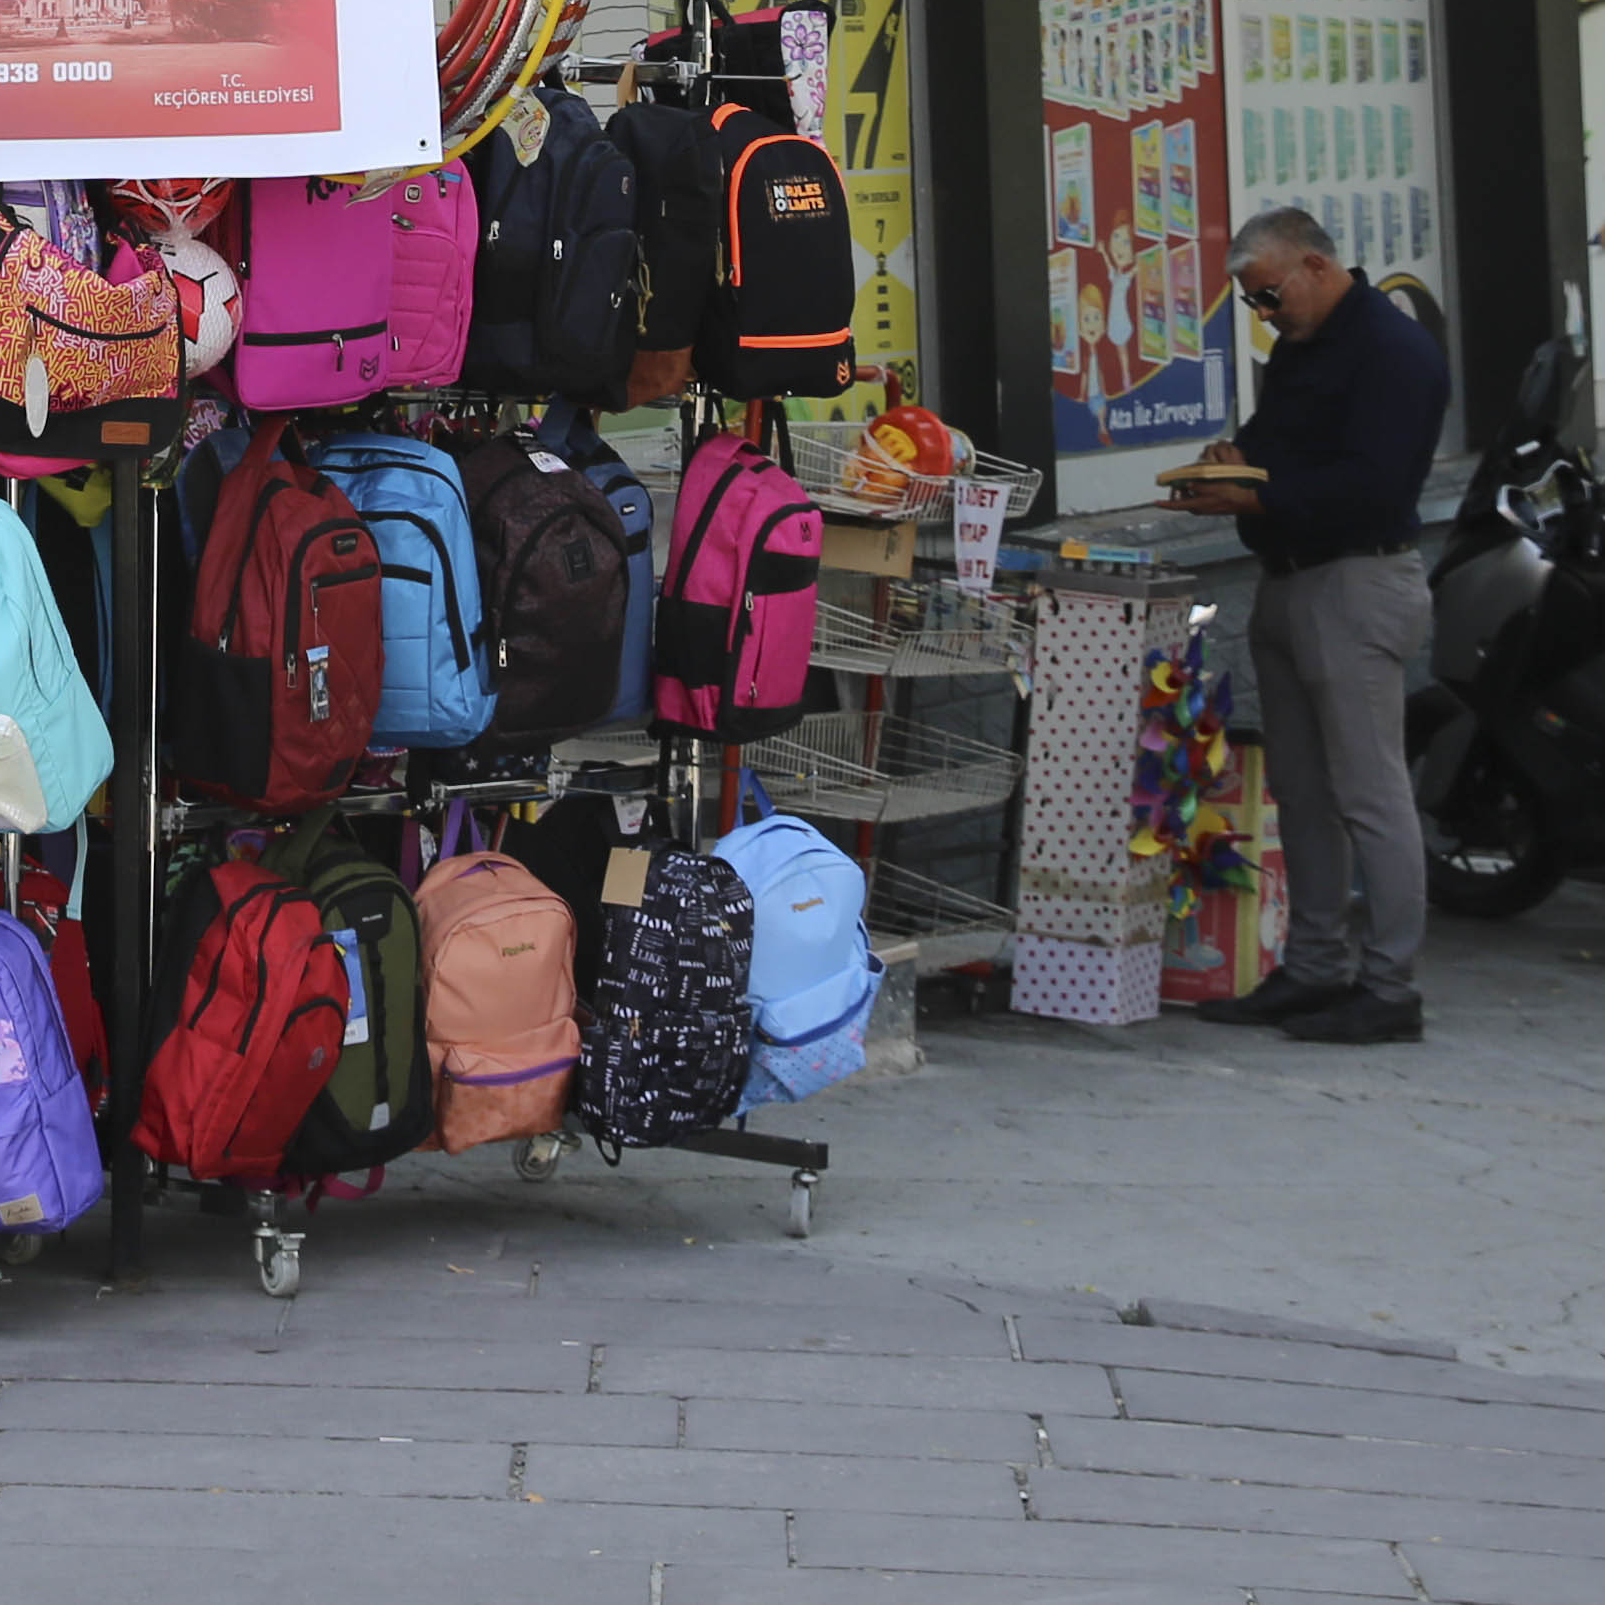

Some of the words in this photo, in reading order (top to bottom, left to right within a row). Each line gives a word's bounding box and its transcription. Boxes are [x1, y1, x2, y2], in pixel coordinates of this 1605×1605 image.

[53, 60, 113, 83] 0000
[220, 73, 246, 88] T.C.
[154, 88, 230, 110] KEÇİÖREN
[233, 85, 315, 105] BELEDİYESİ
